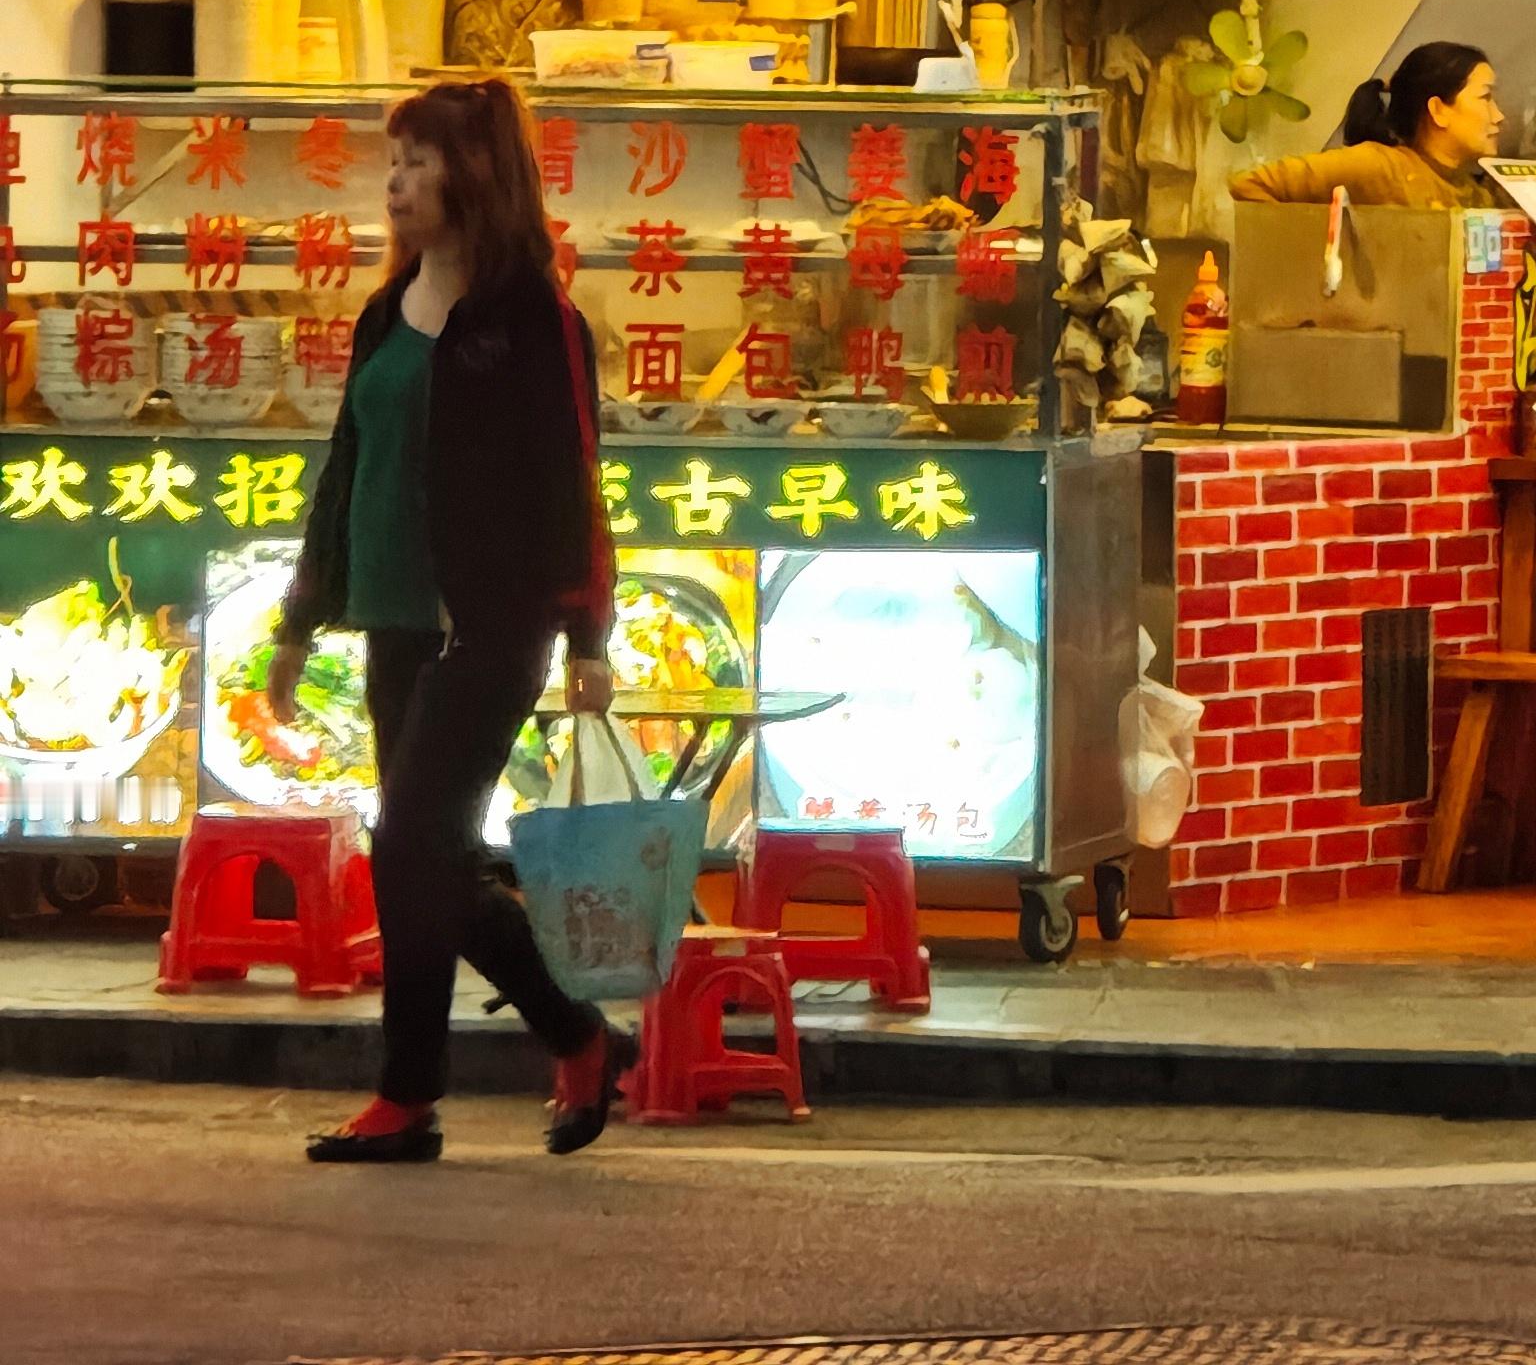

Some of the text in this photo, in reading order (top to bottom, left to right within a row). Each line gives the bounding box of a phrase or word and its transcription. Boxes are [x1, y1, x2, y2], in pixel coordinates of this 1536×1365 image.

[75, 110, 138, 388] 烧肉粽
[185, 115, 249, 388] 米粉汤
[625, 119, 689, 401] 沙茶面
[738, 122, 801, 399] 蟹黄包
